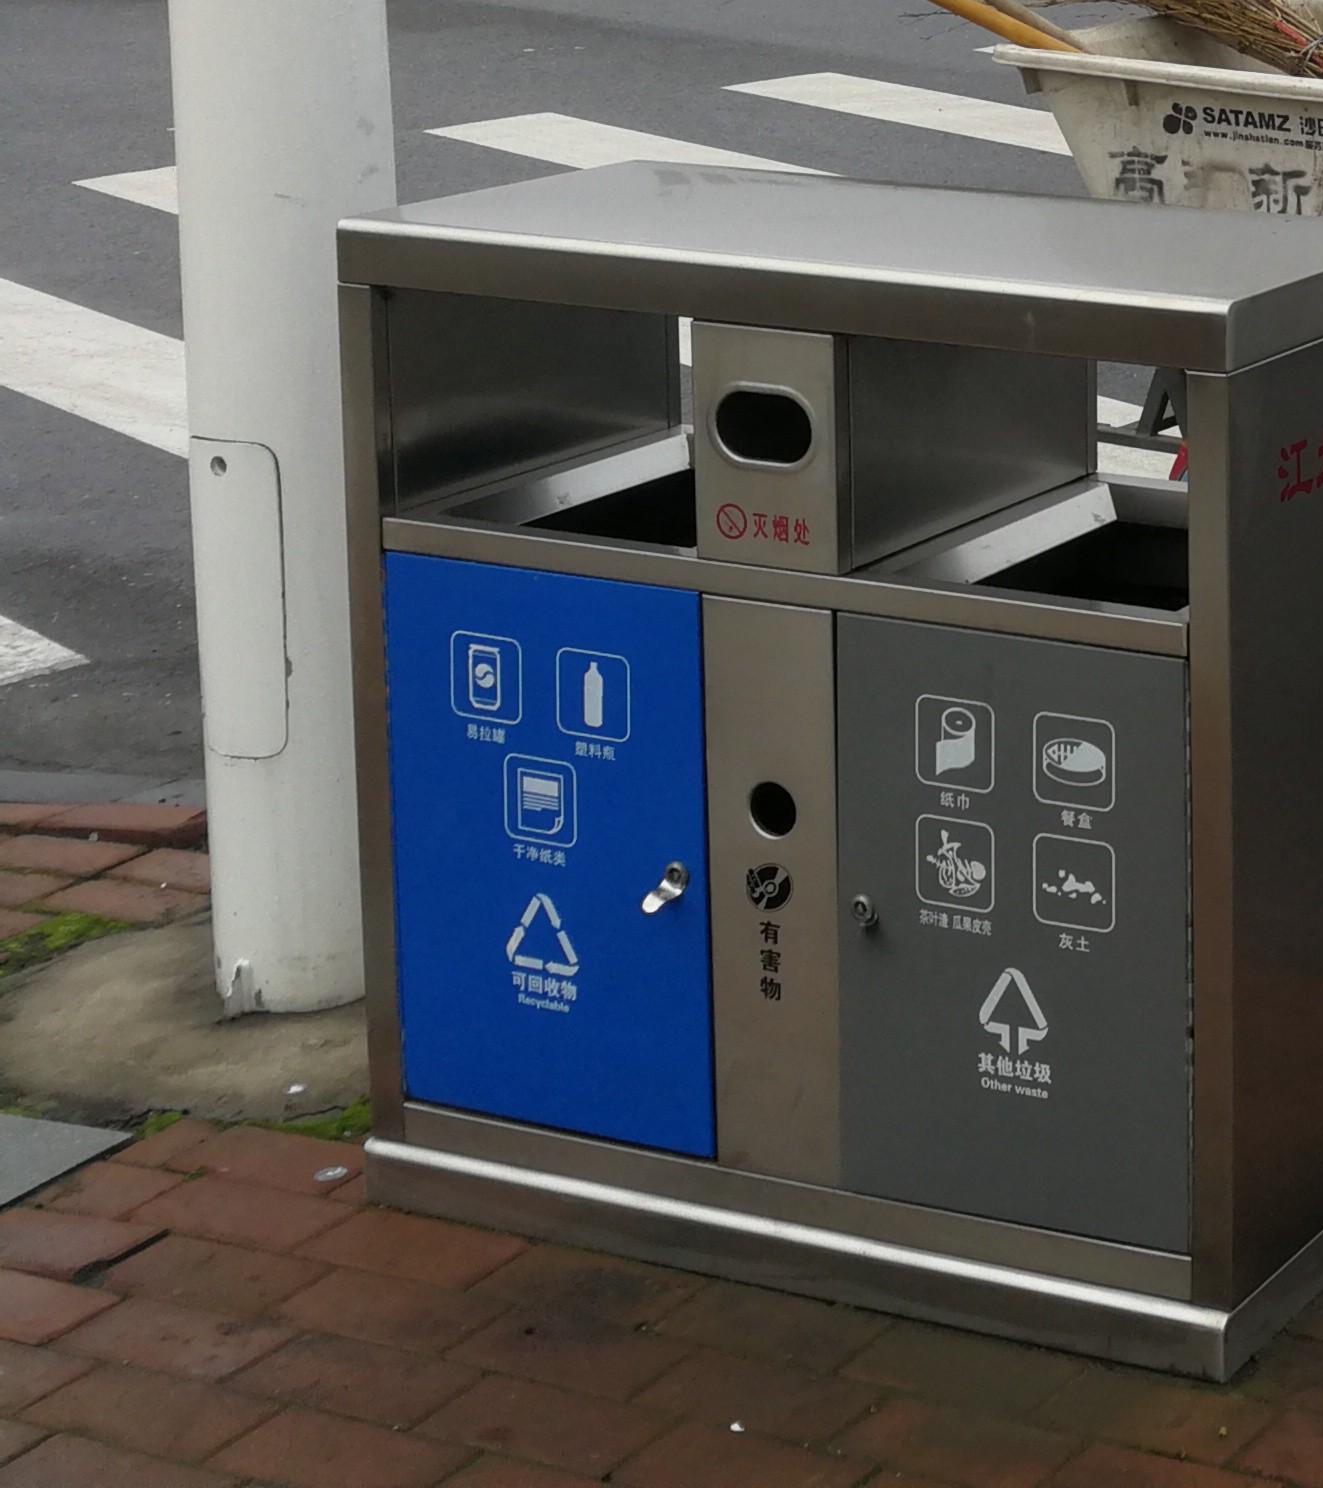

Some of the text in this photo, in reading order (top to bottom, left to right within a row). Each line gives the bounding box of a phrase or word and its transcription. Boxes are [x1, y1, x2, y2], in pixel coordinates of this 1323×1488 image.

[1202, 106, 1292, 132] SATAMZ
[752, 512, 811, 546] 灭烟处
[466, 723, 506, 744] 易拉罐
[574, 741, 616, 761] 塑料瓶
[940, 791, 970, 810] 纸巾
[1060, 809, 1093, 829] 餐盒
[513, 843, 567, 867] 干净纸类
[1058, 933, 1091, 952] 灰土
[759, 920, 782, 1001] 有害物
[511, 971, 577, 1001] 可回收物
[518, 993, 570, 1013] Recyclable
[978, 1052, 1052, 1084] 其他垃圾
[981, 1076, 1049, 1099] Other waste
